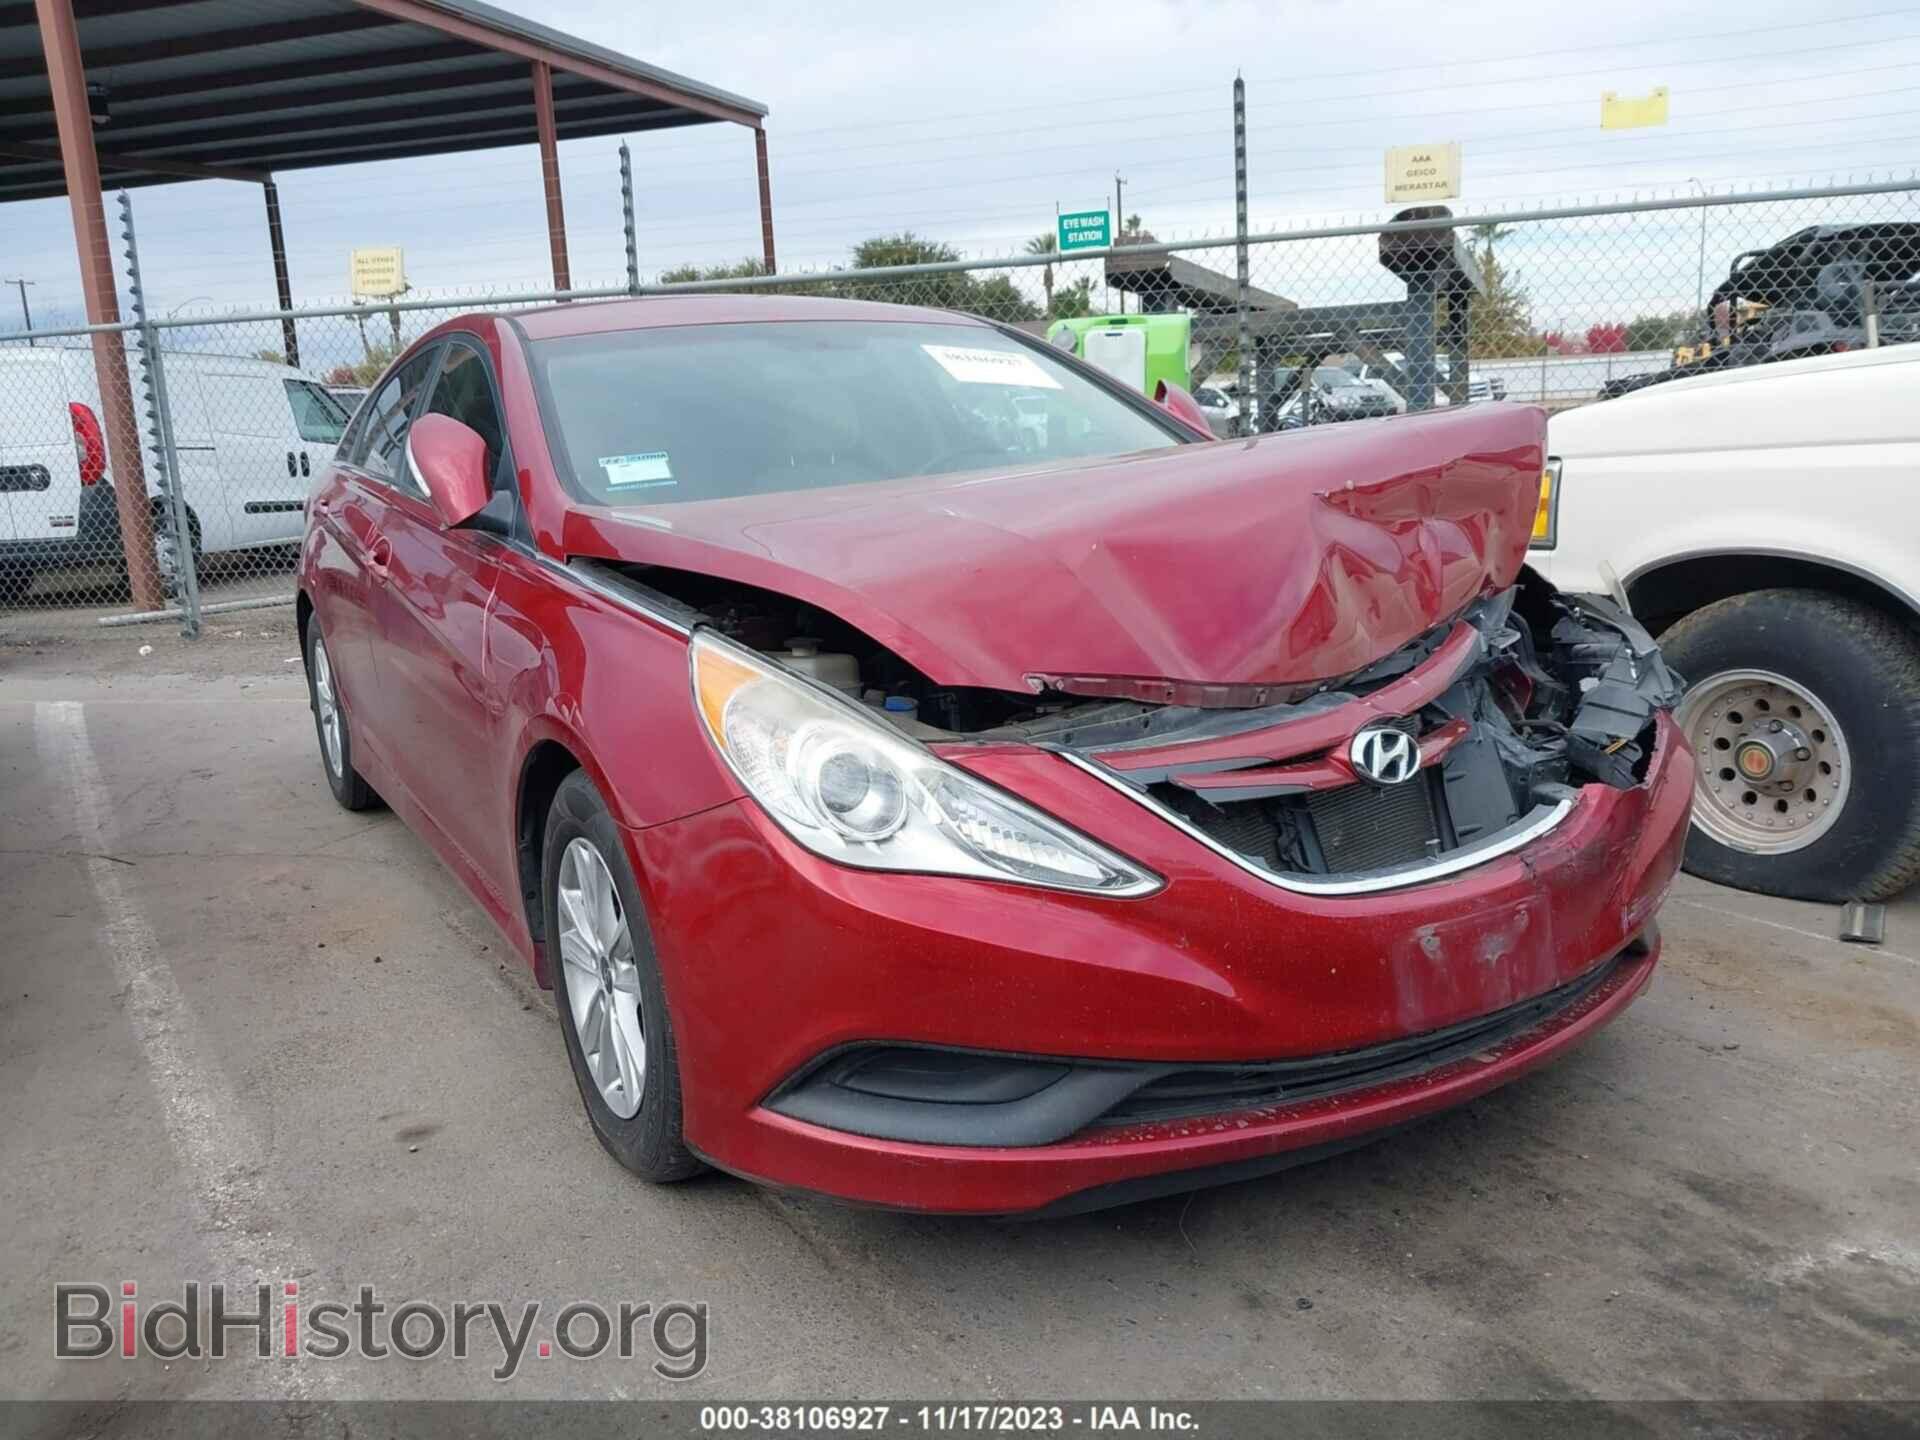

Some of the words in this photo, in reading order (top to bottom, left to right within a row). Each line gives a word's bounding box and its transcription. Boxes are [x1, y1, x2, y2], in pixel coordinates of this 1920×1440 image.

[1411, 154, 1432, 163] AAA
[1406, 167, 1437, 178] GEICO
[1063, 217, 1080, 229] EYE
[1080, 215, 1104, 227] WASH
[1067, 230, 1103, 243] STATION
